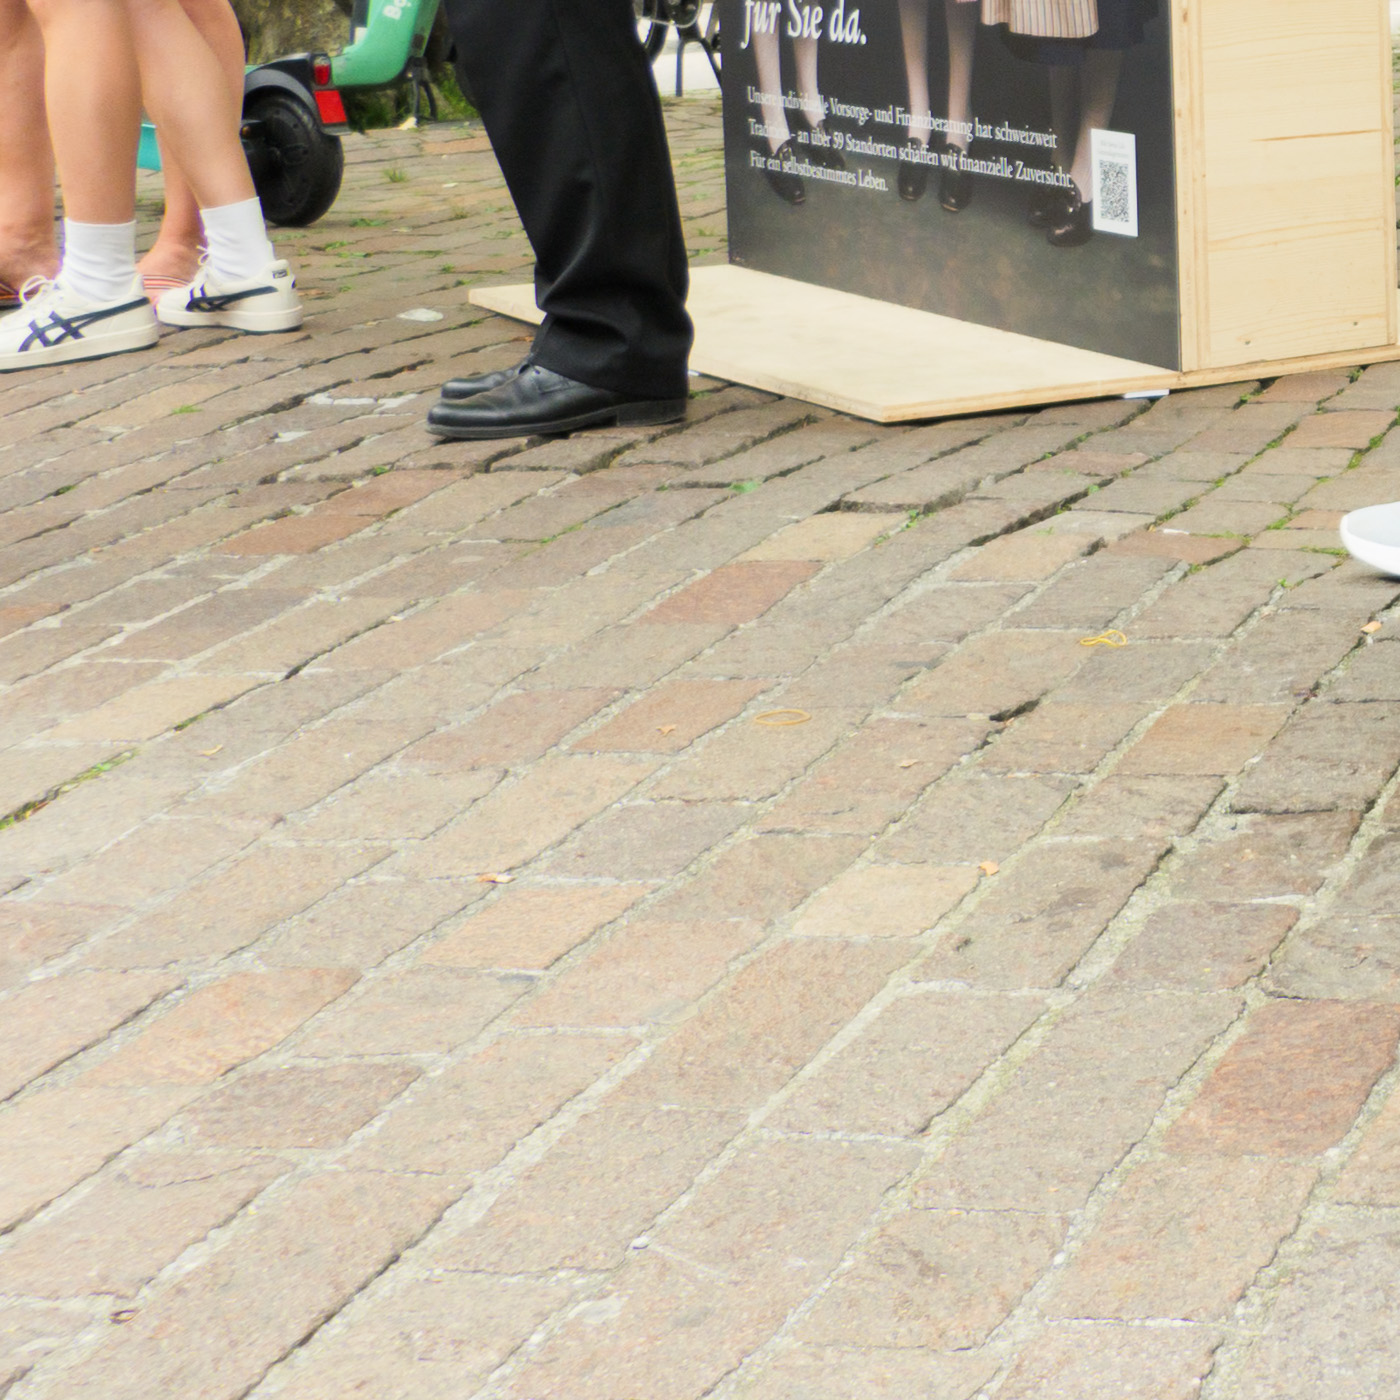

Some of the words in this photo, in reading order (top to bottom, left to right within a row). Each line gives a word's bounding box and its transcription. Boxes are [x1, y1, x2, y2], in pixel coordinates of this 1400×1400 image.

[829, 98, 872, 126] Vorsorge-
[874, 105, 894, 124] und
[975, 117, 993, 139] hat
[994, 121, 1058, 149] schweizweit
[750, 150, 766, 169] Für
[858, 168, 889, 192] Leben.
[797, 131, 809, 144] an
[810, 128, 832, 147] über
[833, 132, 845, 150] 59
[846, 134, 898, 160] Standorten
[900, 142, 940, 167] schaffen
[959, 151, 1014, 178] finanzielle
[1015, 160, 1075, 188] Zuversicht.
